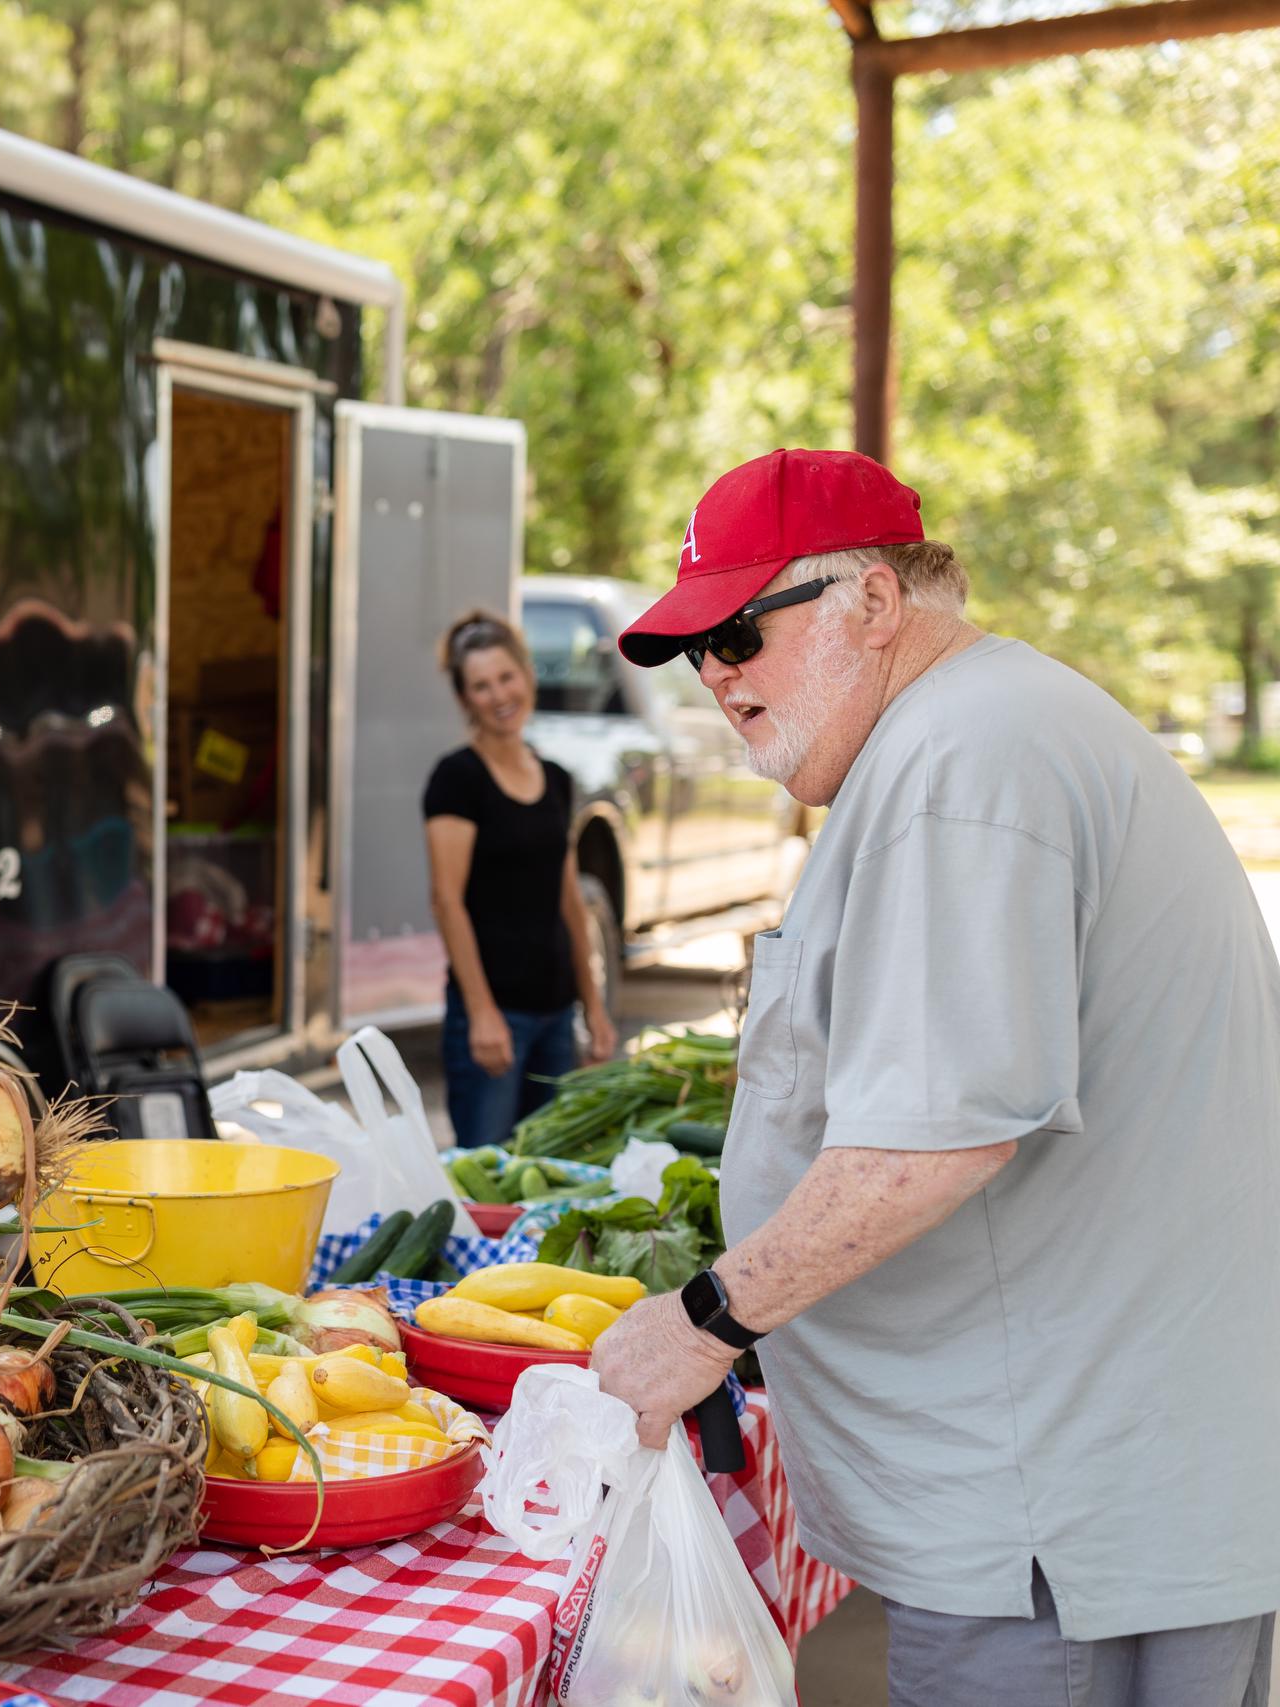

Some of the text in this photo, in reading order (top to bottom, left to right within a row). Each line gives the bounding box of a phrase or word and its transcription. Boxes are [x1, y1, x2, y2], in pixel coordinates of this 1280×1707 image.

[677, 508, 702, 569] A
[560, 1672, 572, 1699] COST
[568, 1643, 583, 1673] PLUS
[577, 1613, 592, 1643] FOOD
